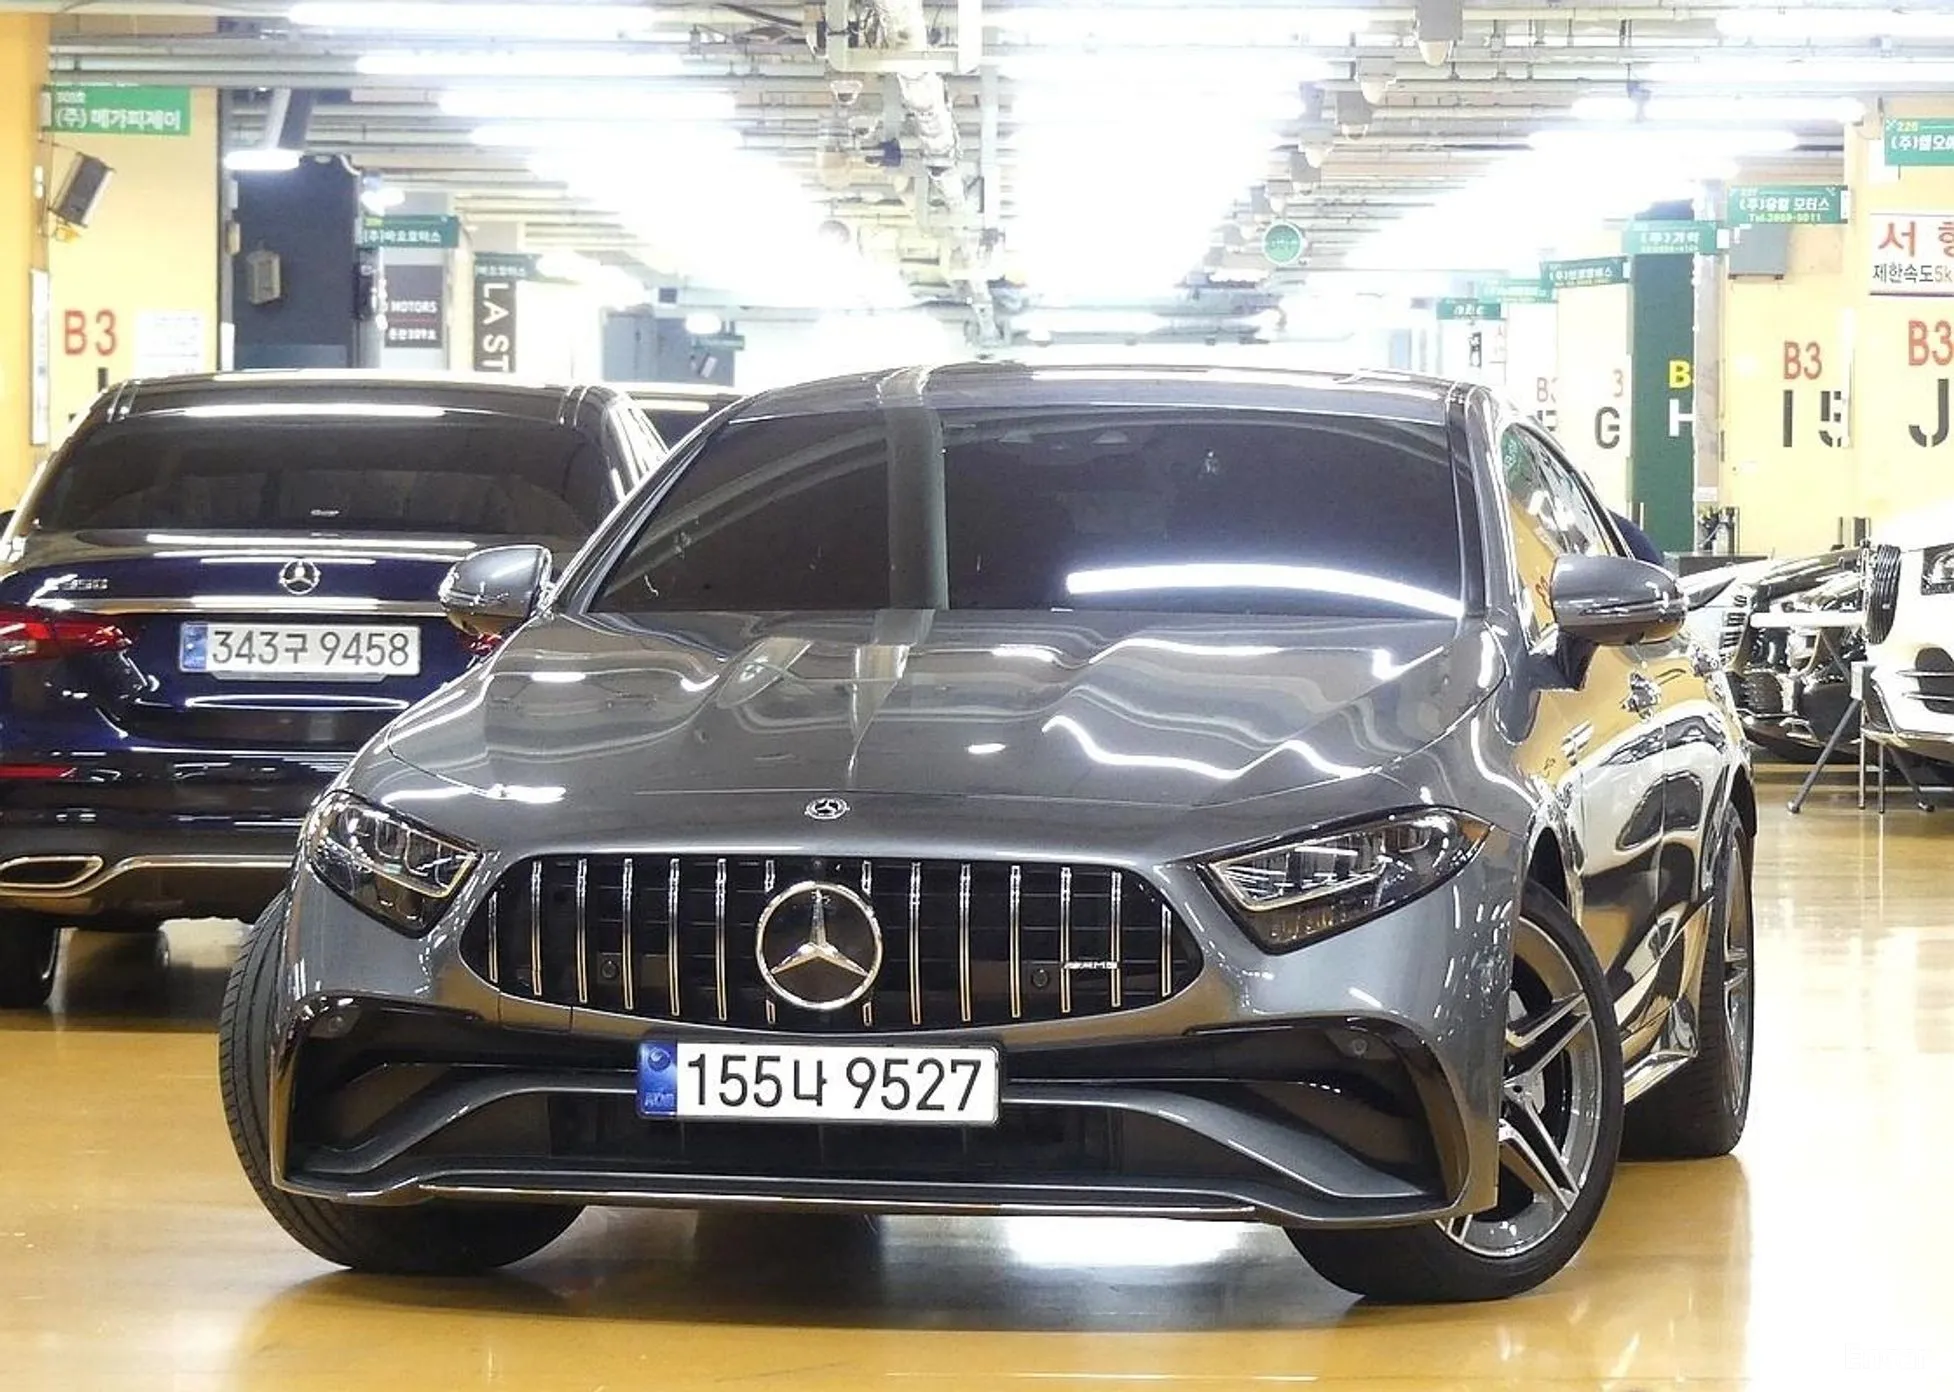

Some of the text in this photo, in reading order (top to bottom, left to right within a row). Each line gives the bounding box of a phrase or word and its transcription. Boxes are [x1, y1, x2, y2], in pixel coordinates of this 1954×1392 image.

[64, 309, 116, 356] B3
[1908, 319, 1953, 366] B3
[1783, 340, 1822, 381] B3
[1594, 406, 1621, 450] G
[212, 630, 410, 667] 343구 9458
[687, 1053, 982, 1111] 155나 9527
